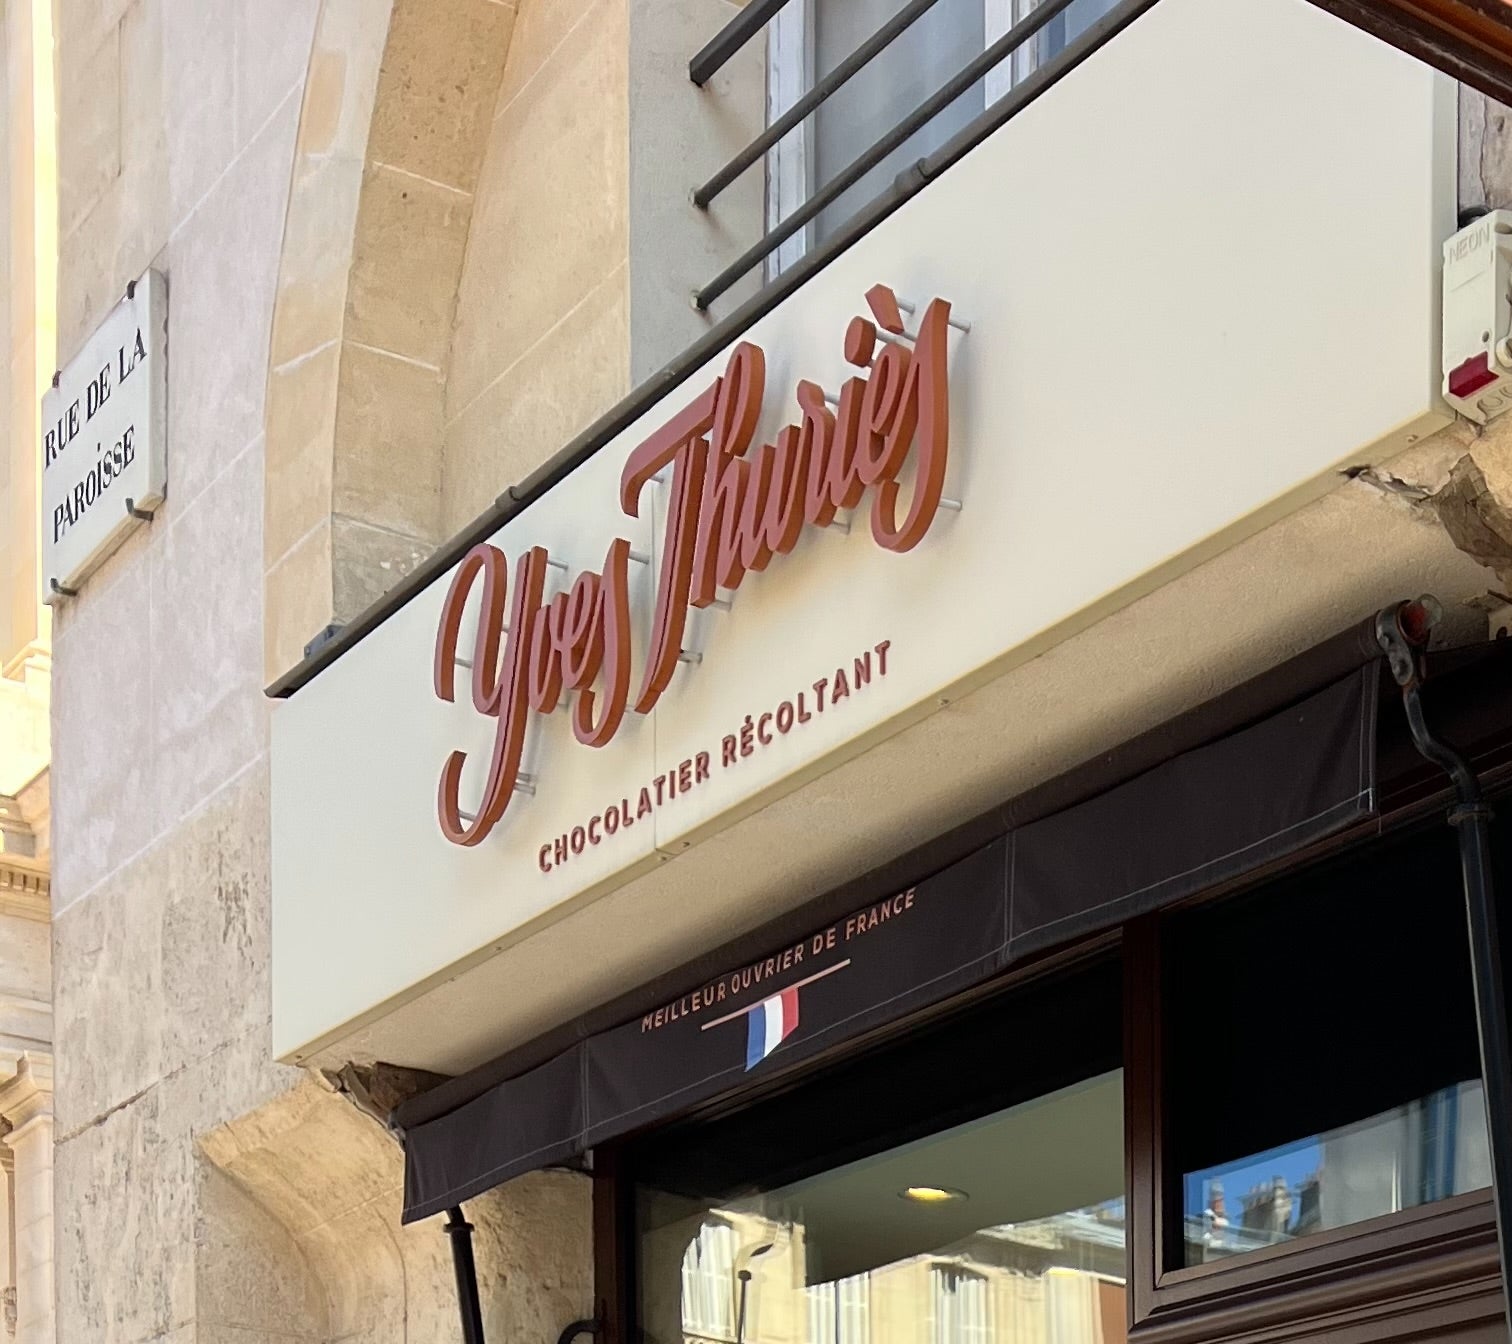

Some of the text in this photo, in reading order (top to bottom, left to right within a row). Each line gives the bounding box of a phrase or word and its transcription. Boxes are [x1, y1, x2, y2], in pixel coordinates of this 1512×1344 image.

[44, 327, 148, 472] RUE DE LA
[53, 424, 136, 545] PAROISSE
[434, 283, 952, 846] Yves Thuriès
[538, 640, 891, 873] CHOCOLATIER RÉCOLTANT
[641, 886, 917, 1033] MEILLEUR OUVRIER DE FRANCE
